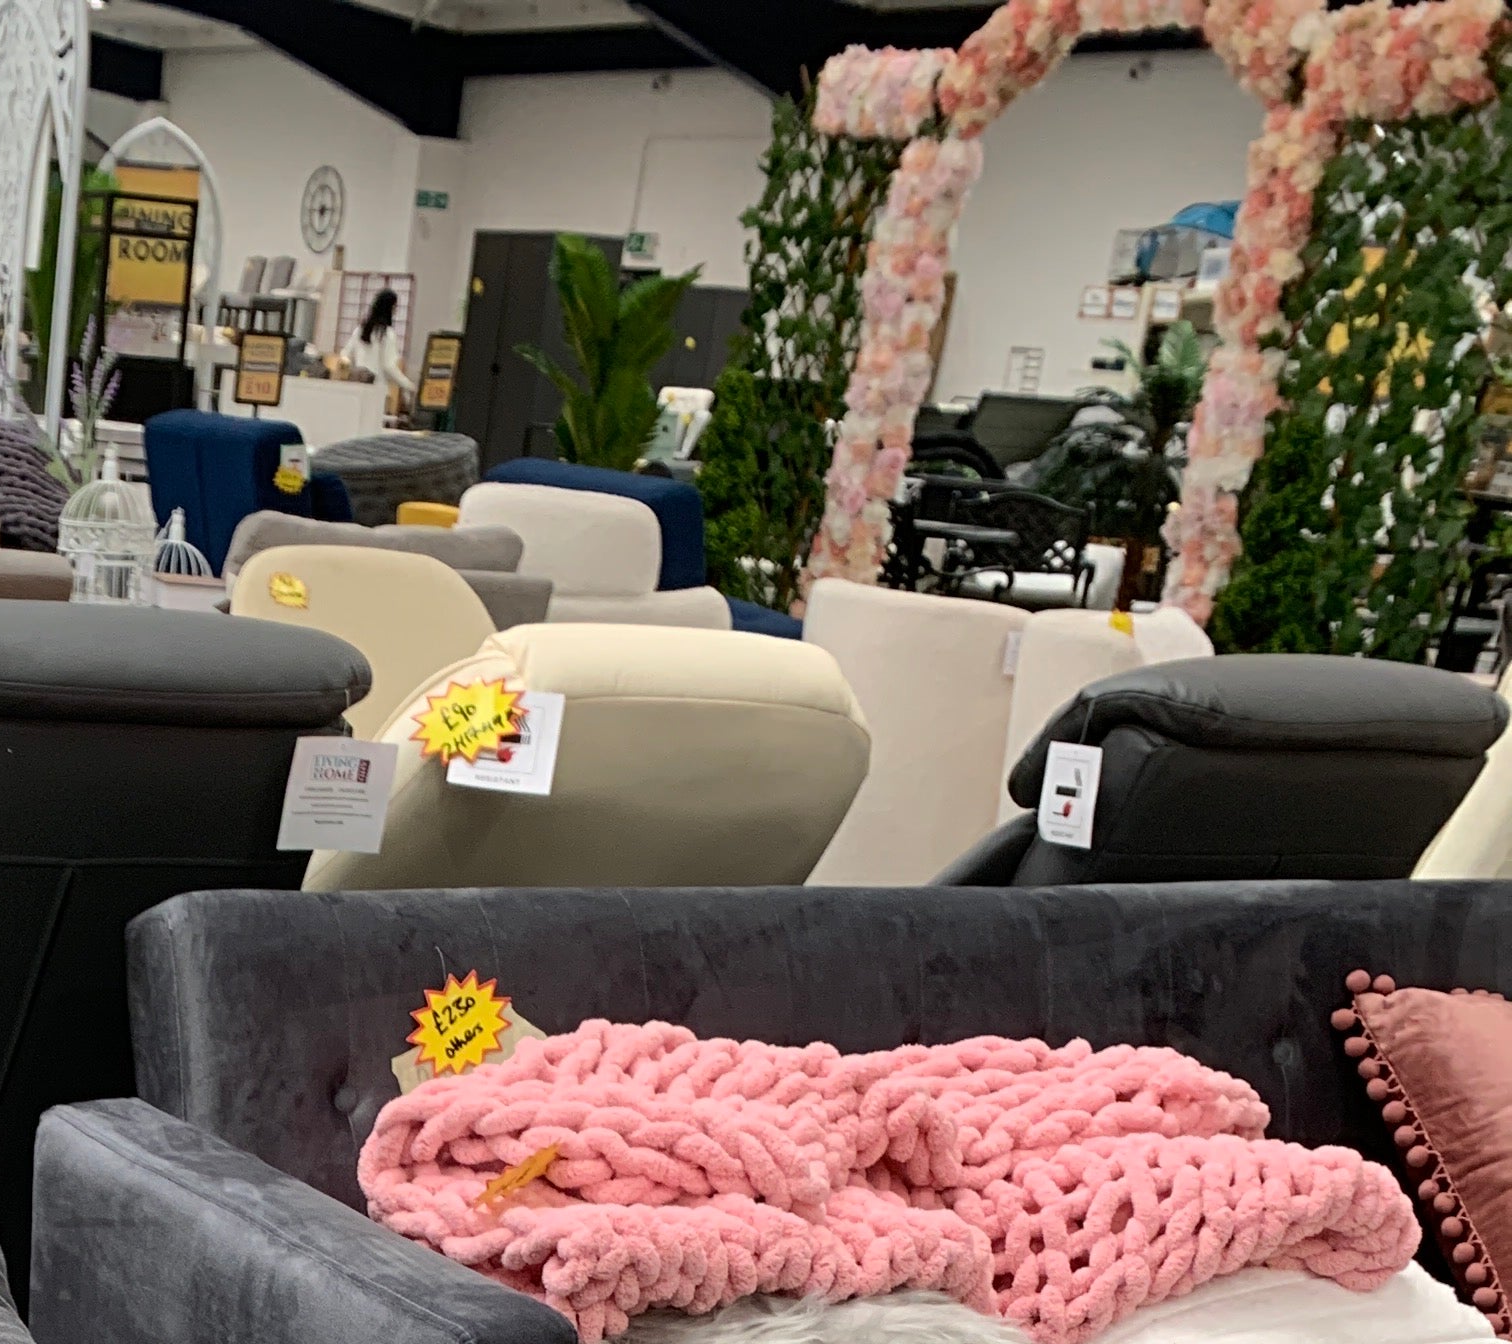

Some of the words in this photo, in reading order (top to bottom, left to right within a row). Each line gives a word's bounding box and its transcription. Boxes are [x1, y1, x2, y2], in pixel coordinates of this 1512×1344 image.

[118, 238, 191, 262] ROOM
[441, 702, 477, 731] £90
[432, 996, 476, 1036] £250
